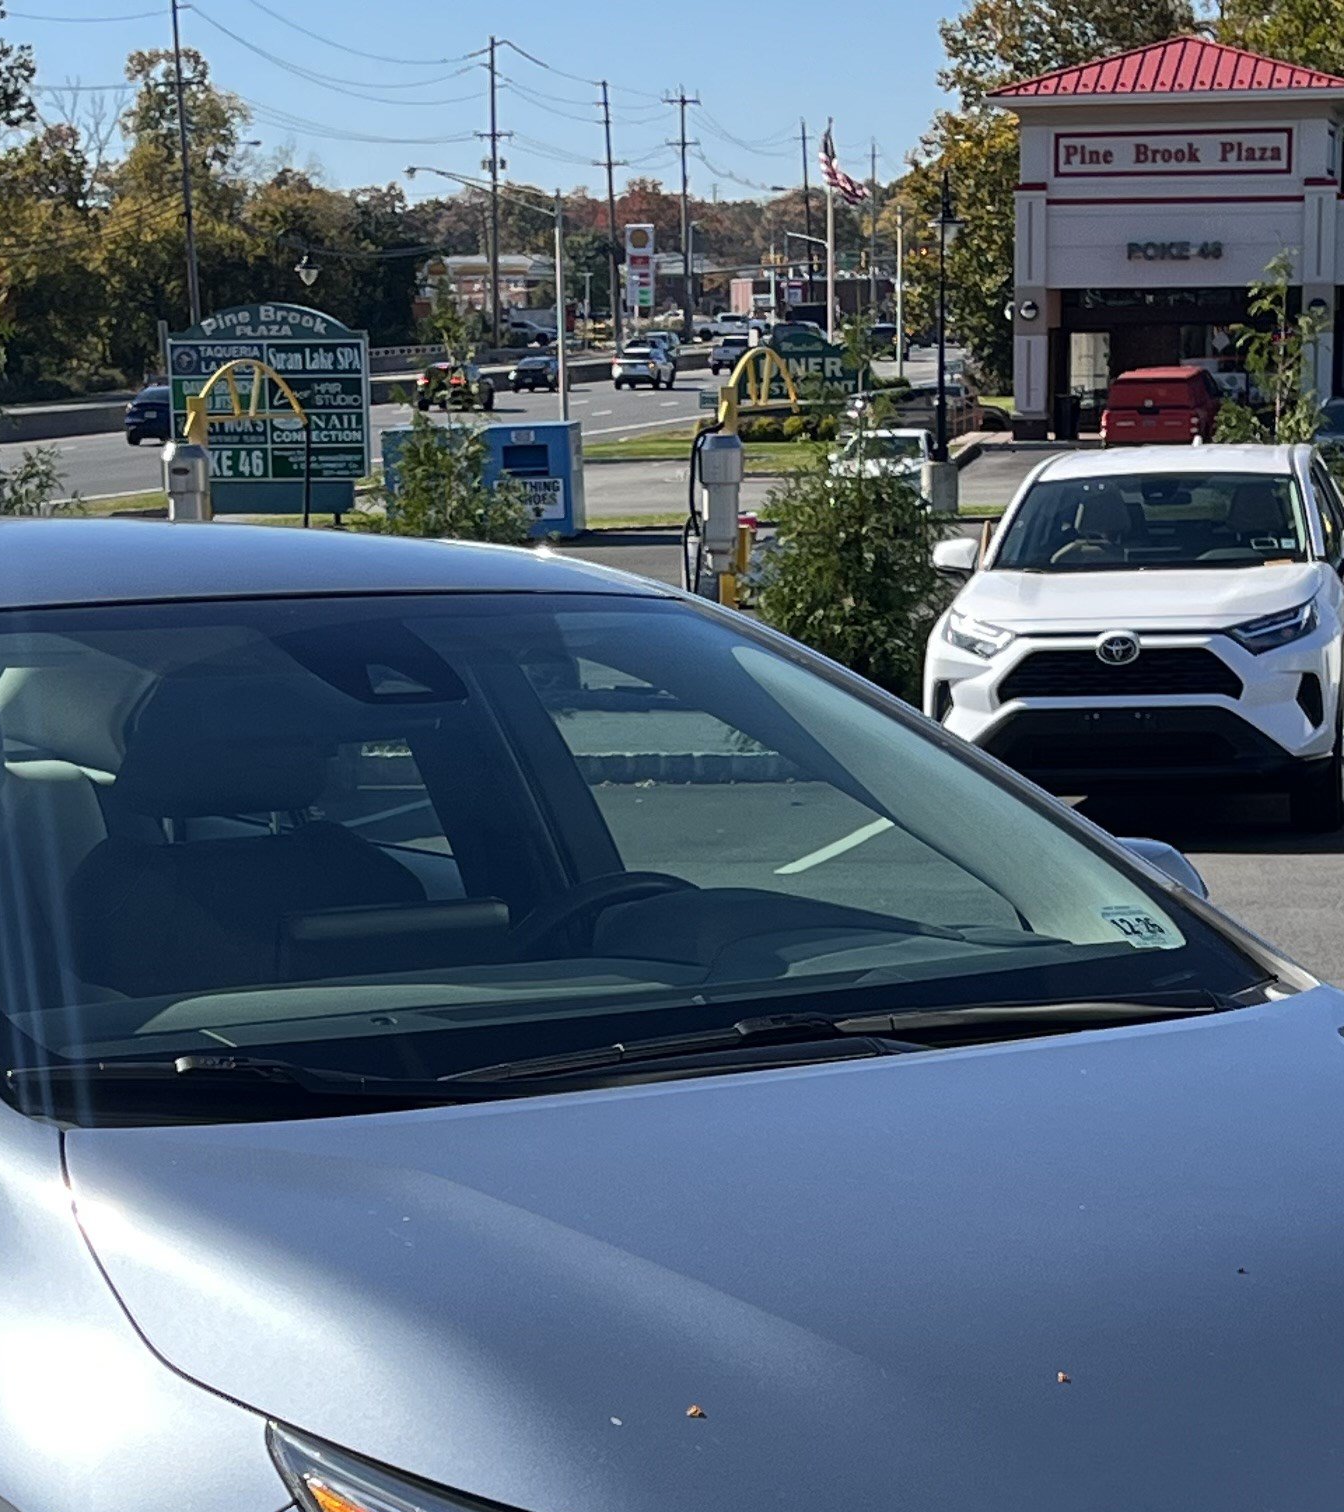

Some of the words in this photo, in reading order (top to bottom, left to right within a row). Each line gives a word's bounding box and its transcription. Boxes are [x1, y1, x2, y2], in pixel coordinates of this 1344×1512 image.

[1063, 144, 1113, 165] Pine
[1133, 142, 1201, 164] Brook
[1219, 140, 1283, 162] Plaza
[201, 311, 250, 336] Pine
[259, 305, 327, 335] Brook
[235, 325, 293, 337] PLAZA
[198, 346, 261, 358] TAQUERIA
[314, 394, 362, 406] STUDIO
[311, 415, 362, 429] NAIL
[238, 450, 264, 476] 46
